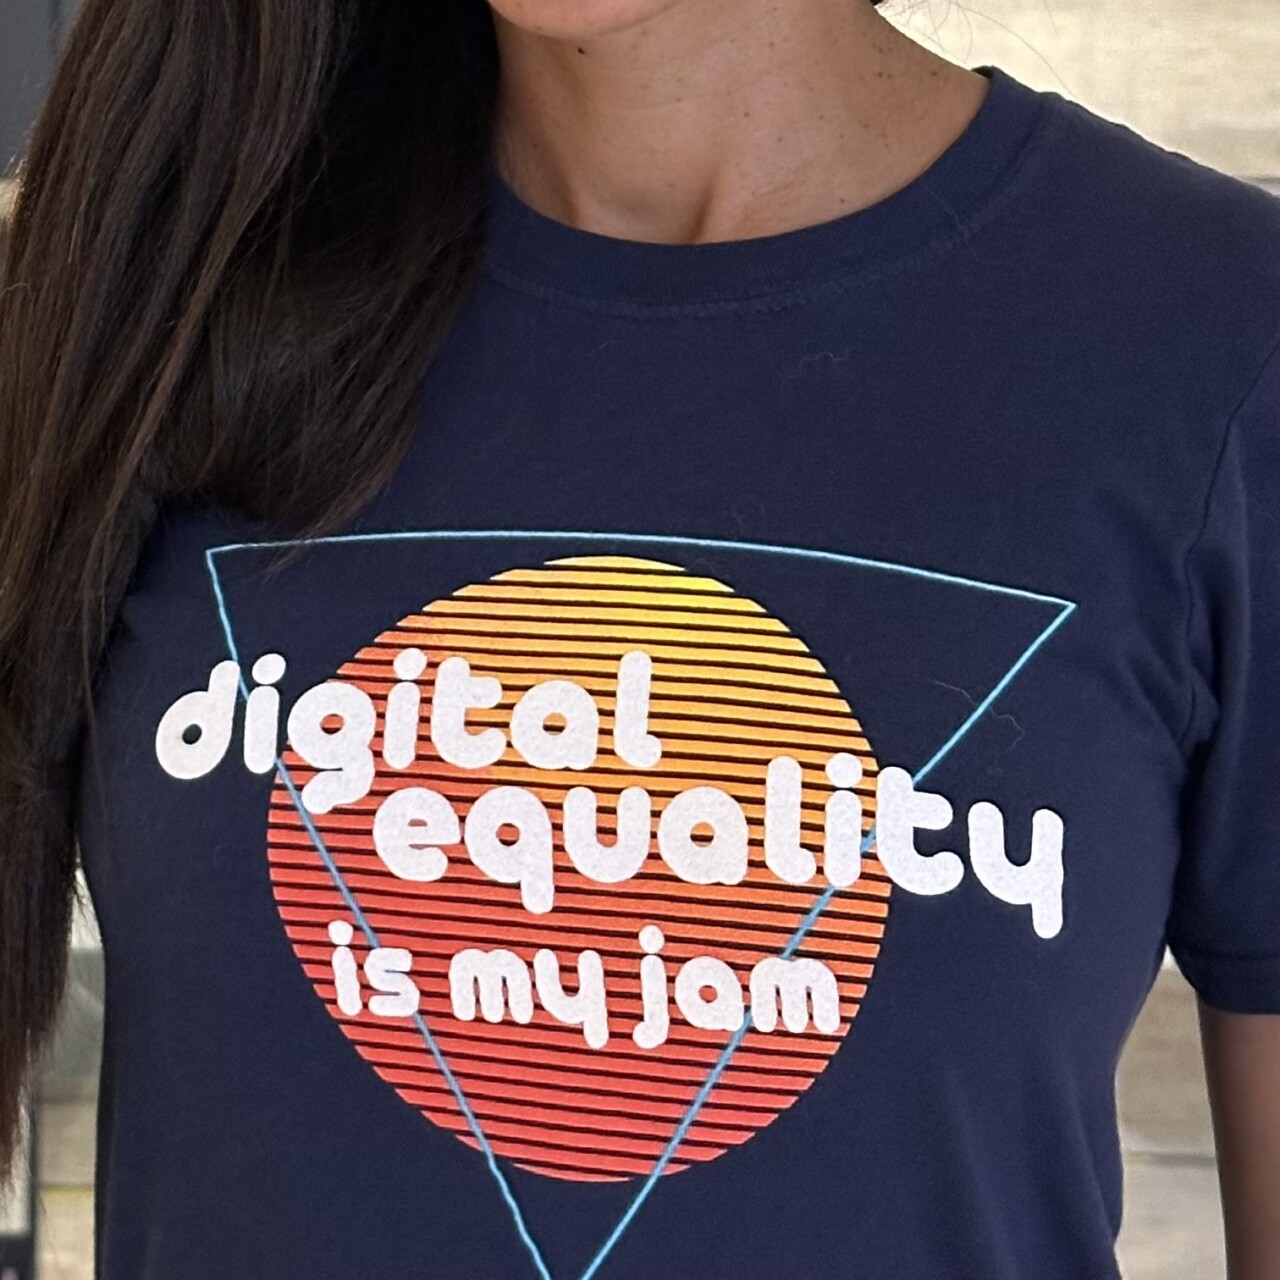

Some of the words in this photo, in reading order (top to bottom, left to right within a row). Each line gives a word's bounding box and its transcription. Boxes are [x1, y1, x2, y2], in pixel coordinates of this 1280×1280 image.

[156, 649, 661, 812] digital
[373, 753, 1064, 938] equality
[328, 921, 419, 1016] is
[449, 949, 609, 1048] my
[633, 925, 840, 1048] jam
